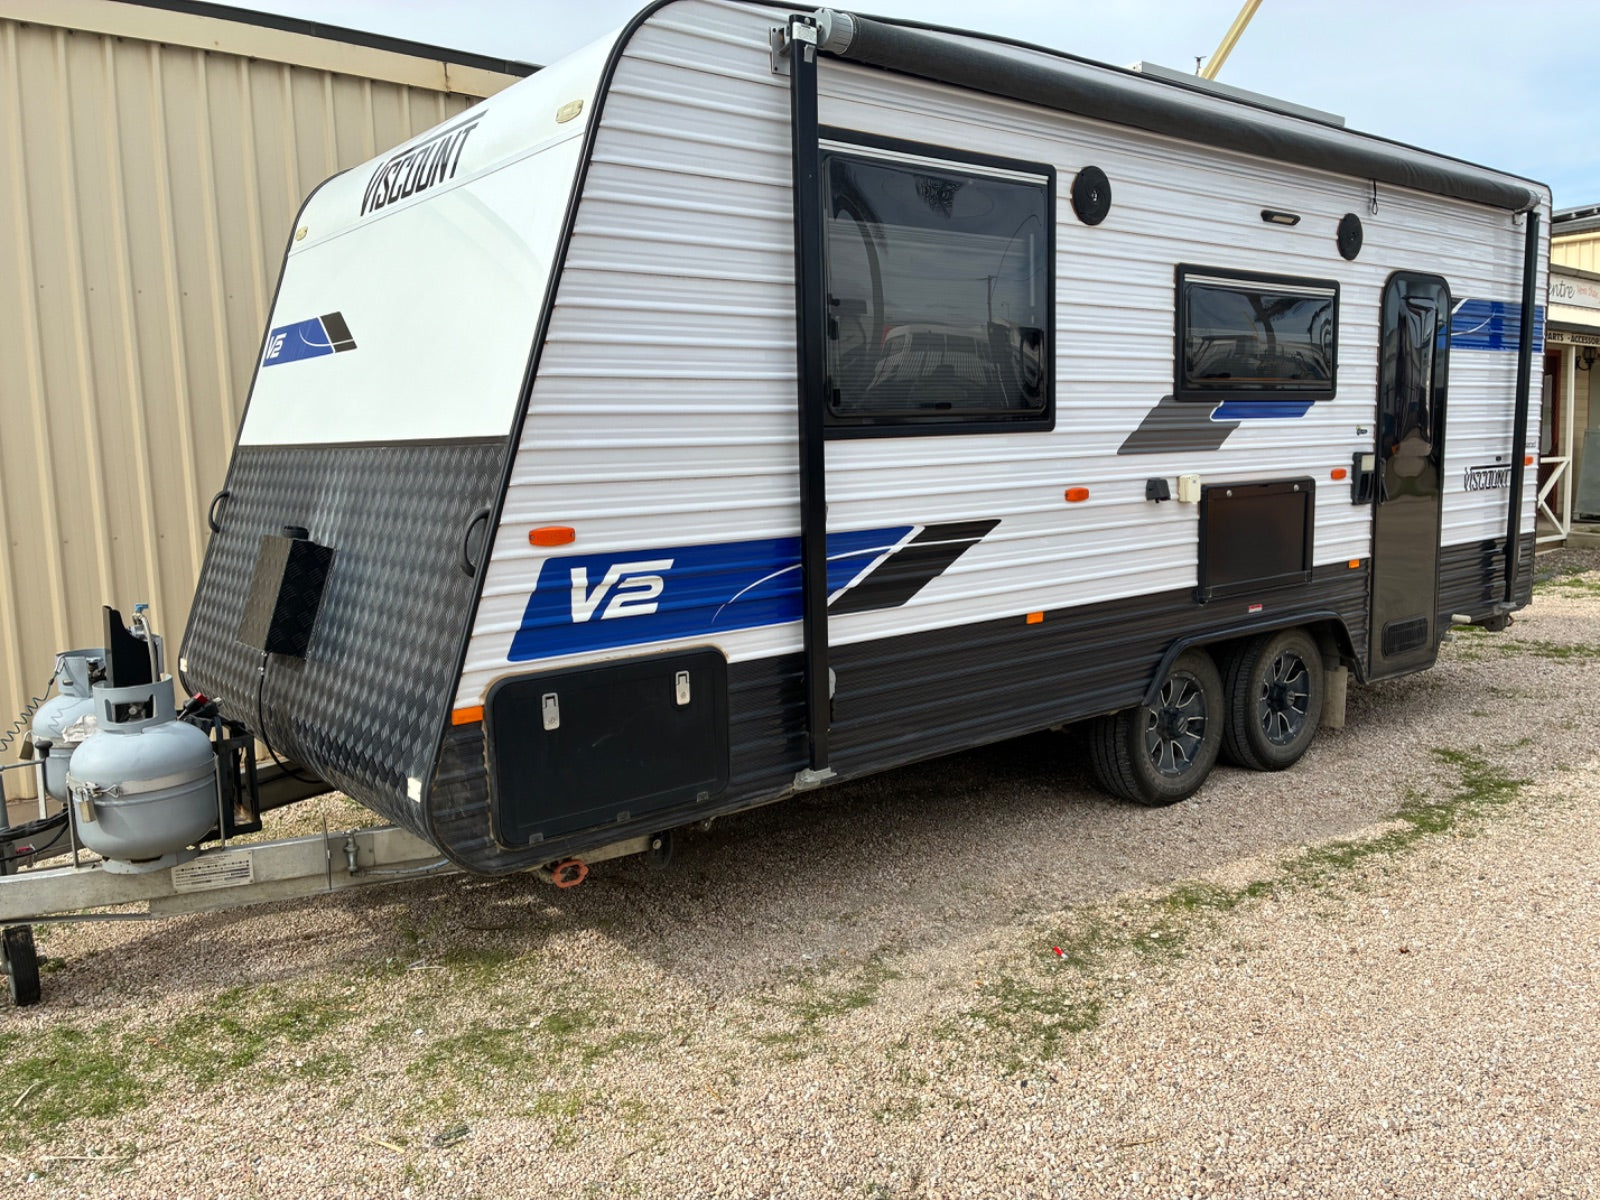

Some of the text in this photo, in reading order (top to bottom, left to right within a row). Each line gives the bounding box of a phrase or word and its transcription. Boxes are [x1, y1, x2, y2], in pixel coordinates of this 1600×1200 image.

[360, 109, 489, 217] VISCOUNT
[1549, 280, 1576, 299] ntre
[265, 332, 288, 360] V2
[1546, 331, 1564, 342] ARTS
[570, 558, 675, 623] V2
